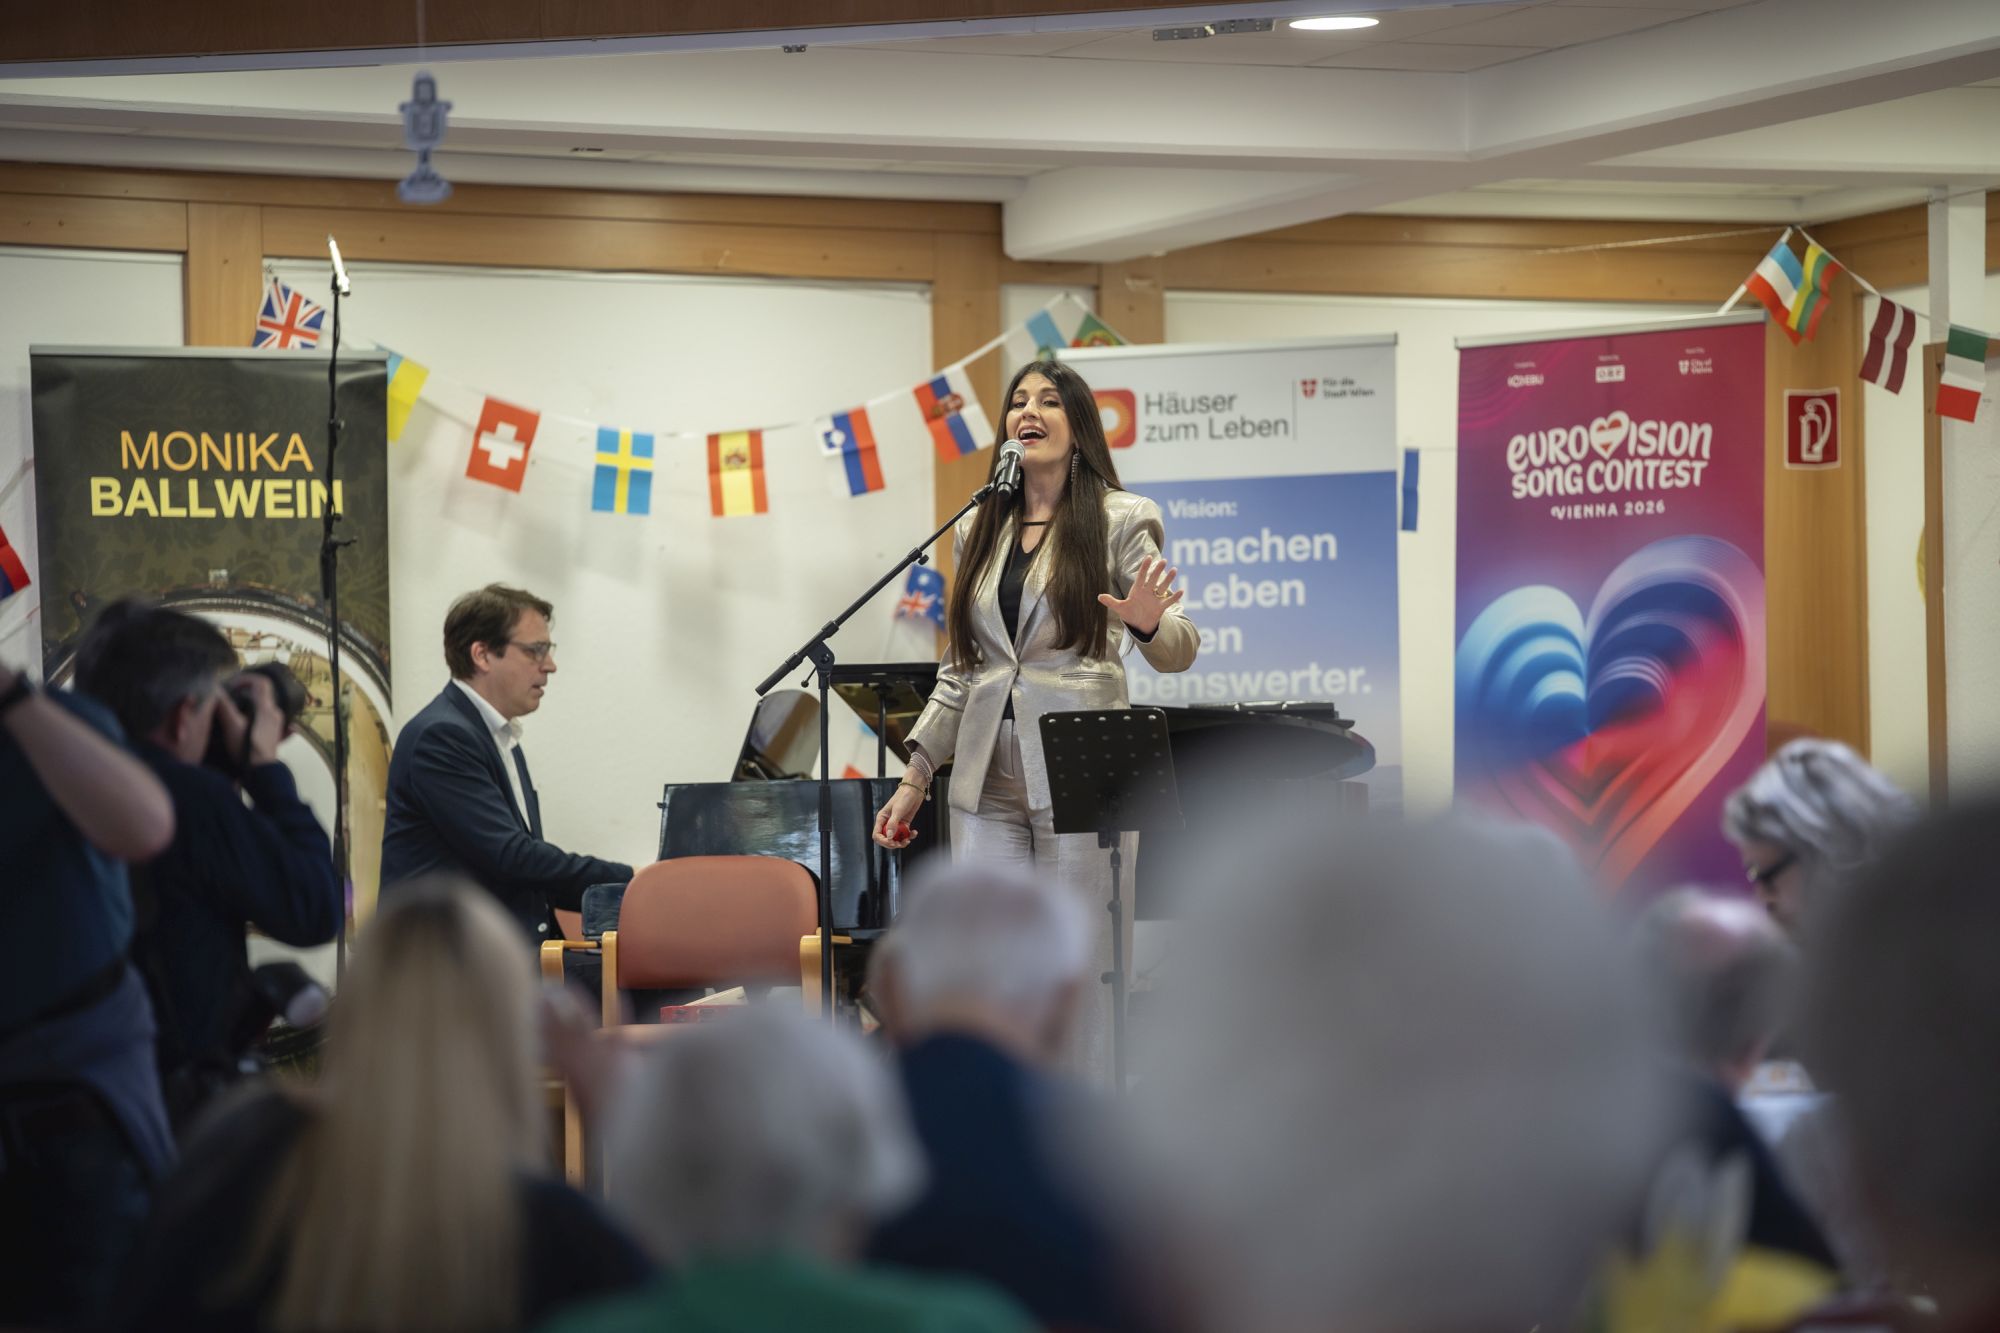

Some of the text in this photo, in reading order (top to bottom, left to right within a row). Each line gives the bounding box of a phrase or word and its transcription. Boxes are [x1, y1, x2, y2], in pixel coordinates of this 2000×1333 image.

[1144, 391, 1237, 416] Häuser
[1144, 414, 1289, 443] zum Leben
[120, 430, 314, 473] MONIKA
[90, 476, 344, 519] BALLWEIN
[1167, 499, 1238, 519] Vision:
[1550, 500, 1666, 520] VIENNA 2026
[1171, 528, 1338, 566] machen
[1178, 574, 1306, 610] Leben
[1200, 625, 1243, 654] en
[1129, 662, 1372, 701] benswerter.
